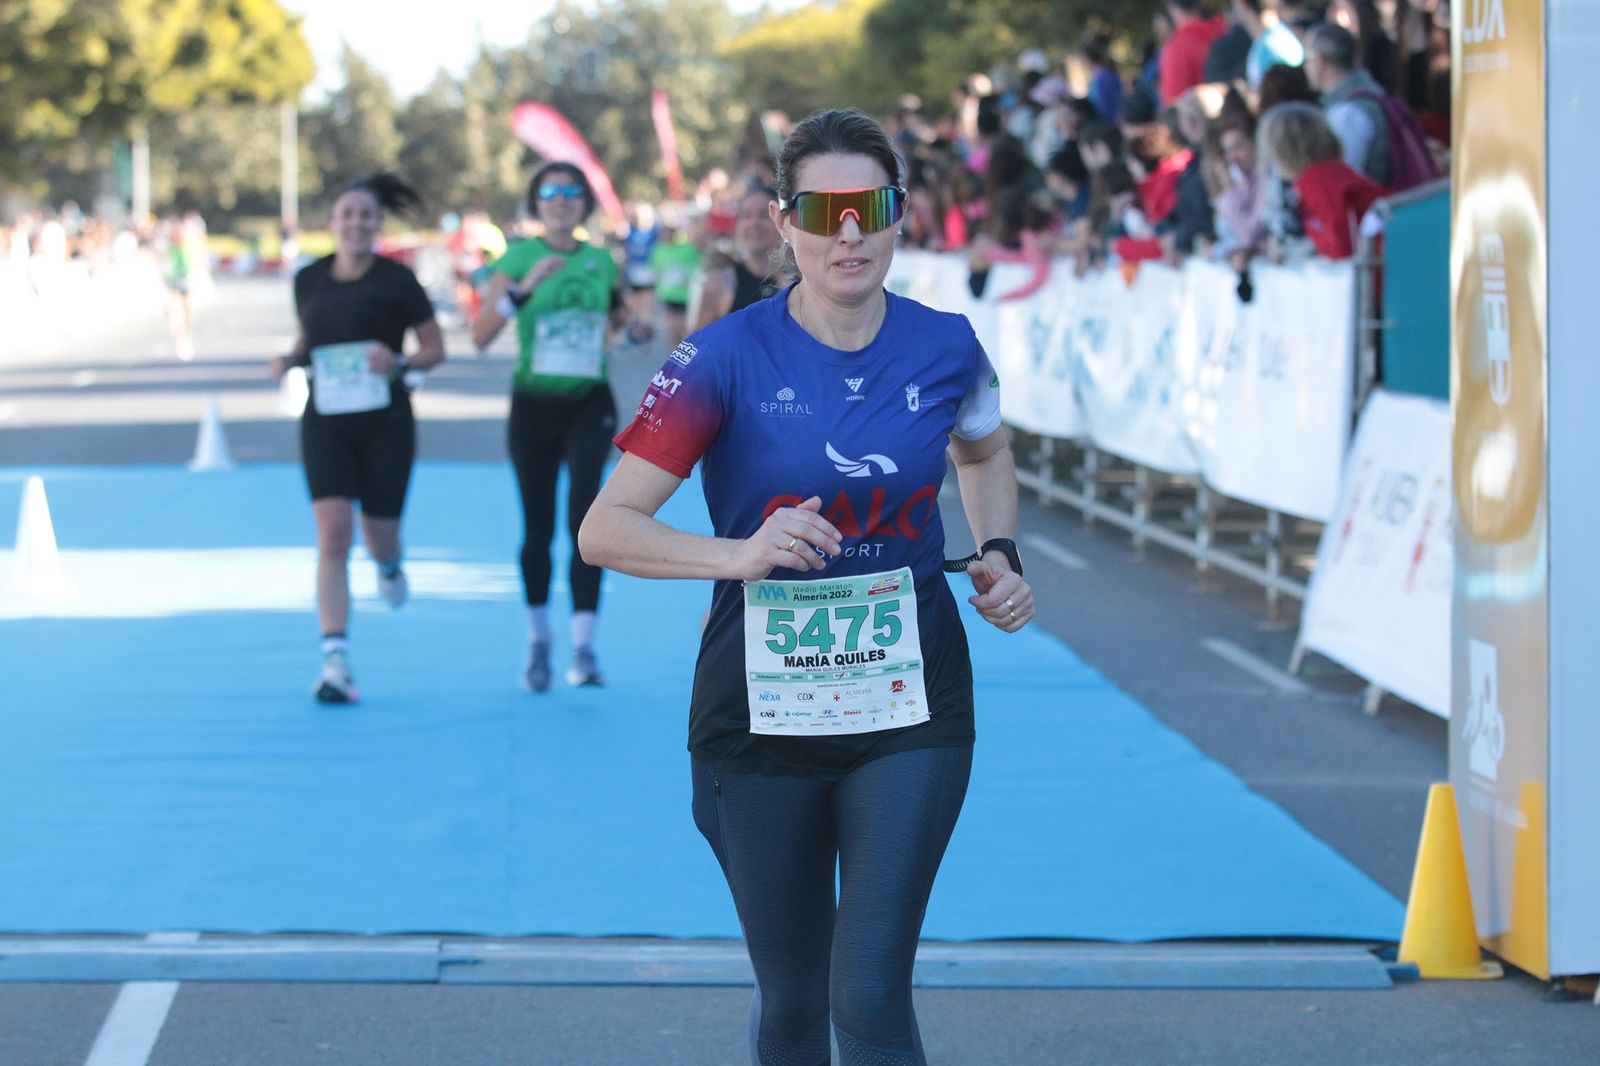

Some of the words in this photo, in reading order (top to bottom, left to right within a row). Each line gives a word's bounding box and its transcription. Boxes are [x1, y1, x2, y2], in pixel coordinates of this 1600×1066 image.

[760, 402, 813, 415] SPIRAL
[816, 543, 884, 558] SORT
[793, 591, 828, 602] Almería
[765, 599, 903, 655] 5475
[784, 653, 831, 668] MARÍA
[834, 649, 887, 667] QUILES
[758, 692, 781, 702] NEXA
[797, 691, 815, 701] CDX
